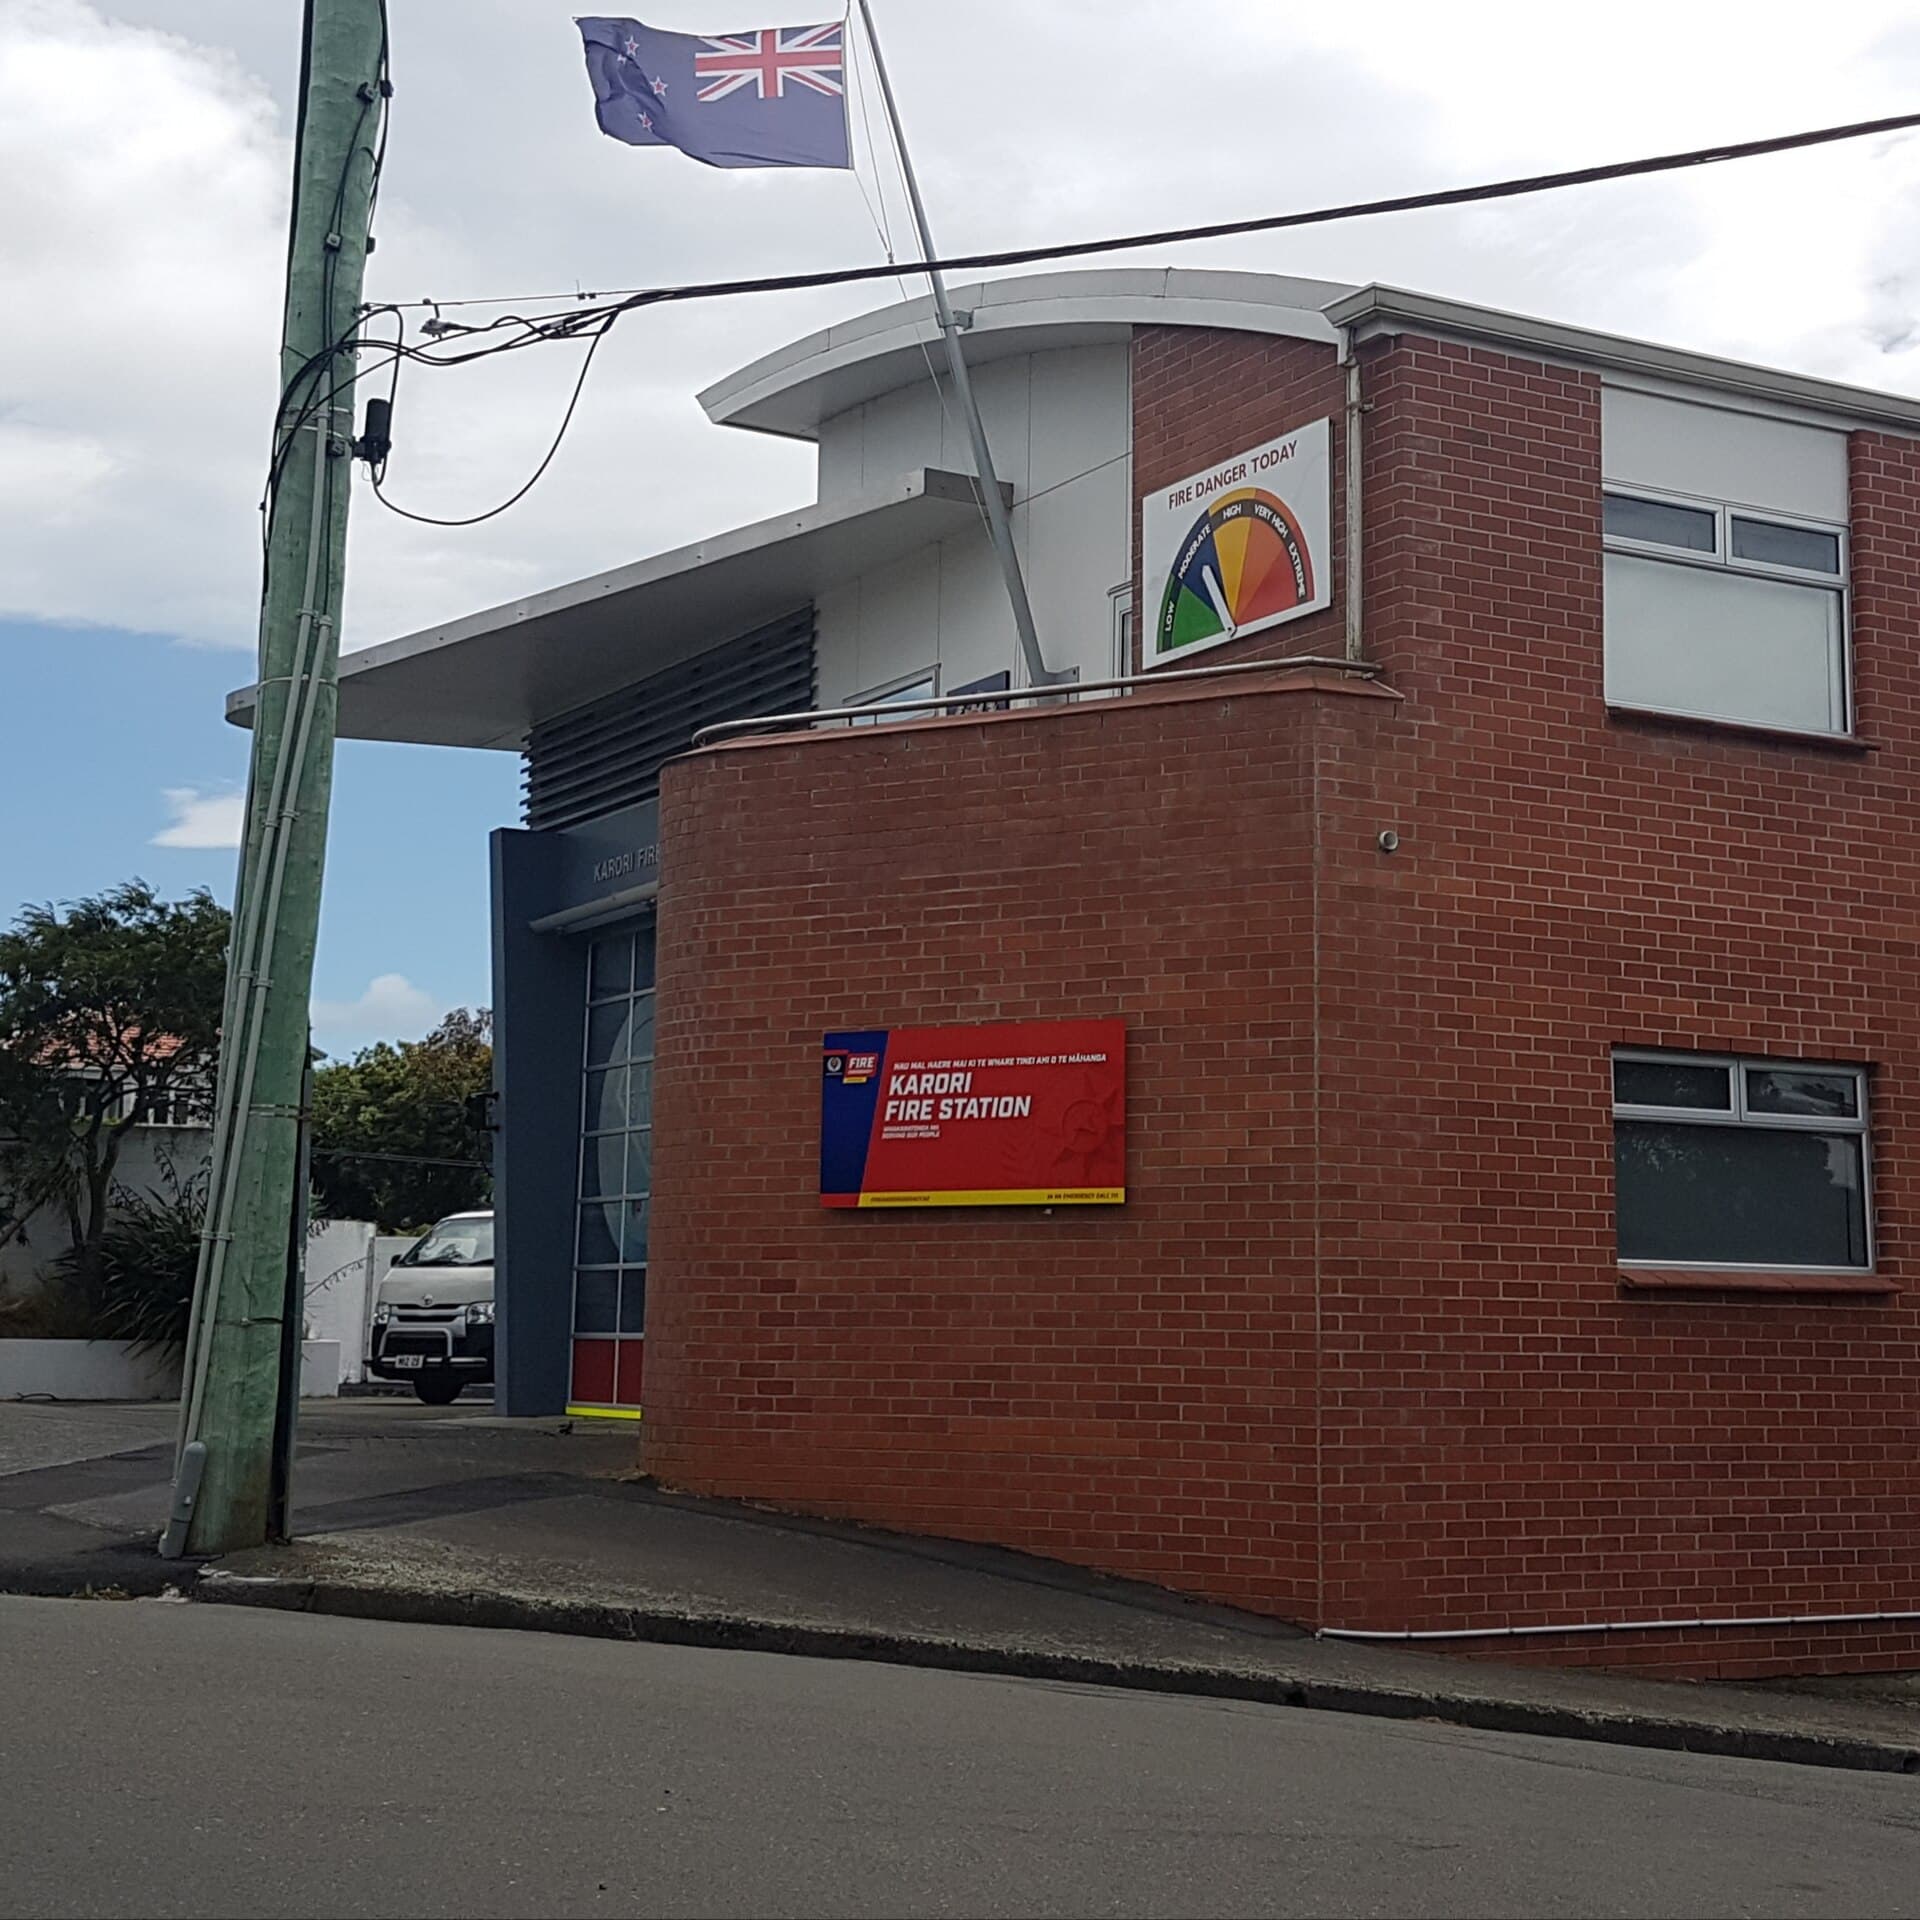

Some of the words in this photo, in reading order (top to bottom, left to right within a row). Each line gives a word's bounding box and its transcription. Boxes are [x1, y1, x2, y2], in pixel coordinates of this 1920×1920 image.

[1168, 485, 1192, 510] FIRE
[1195, 463, 1247, 499] DANGER
[1251, 440, 1297, 473] TODAY
[1222, 503, 1242, 520] HIGH
[1254, 503, 1274, 521] VERY
[1271, 514, 1288, 538] HIGH
[1178, 523, 1212, 580] MODERATE
[1288, 541, 1306, 598] EXTREME
[1165, 601, 1175, 632] LOW
[593, 852, 634, 882] KARORI
[848, 1056, 875, 1069] FIRE
[1058, 1055, 1068, 1064] TE
[889, 1072, 972, 1096] KARORI
[885, 1099, 935, 1121] FIRE
[938, 1095, 1031, 1120] STATION
